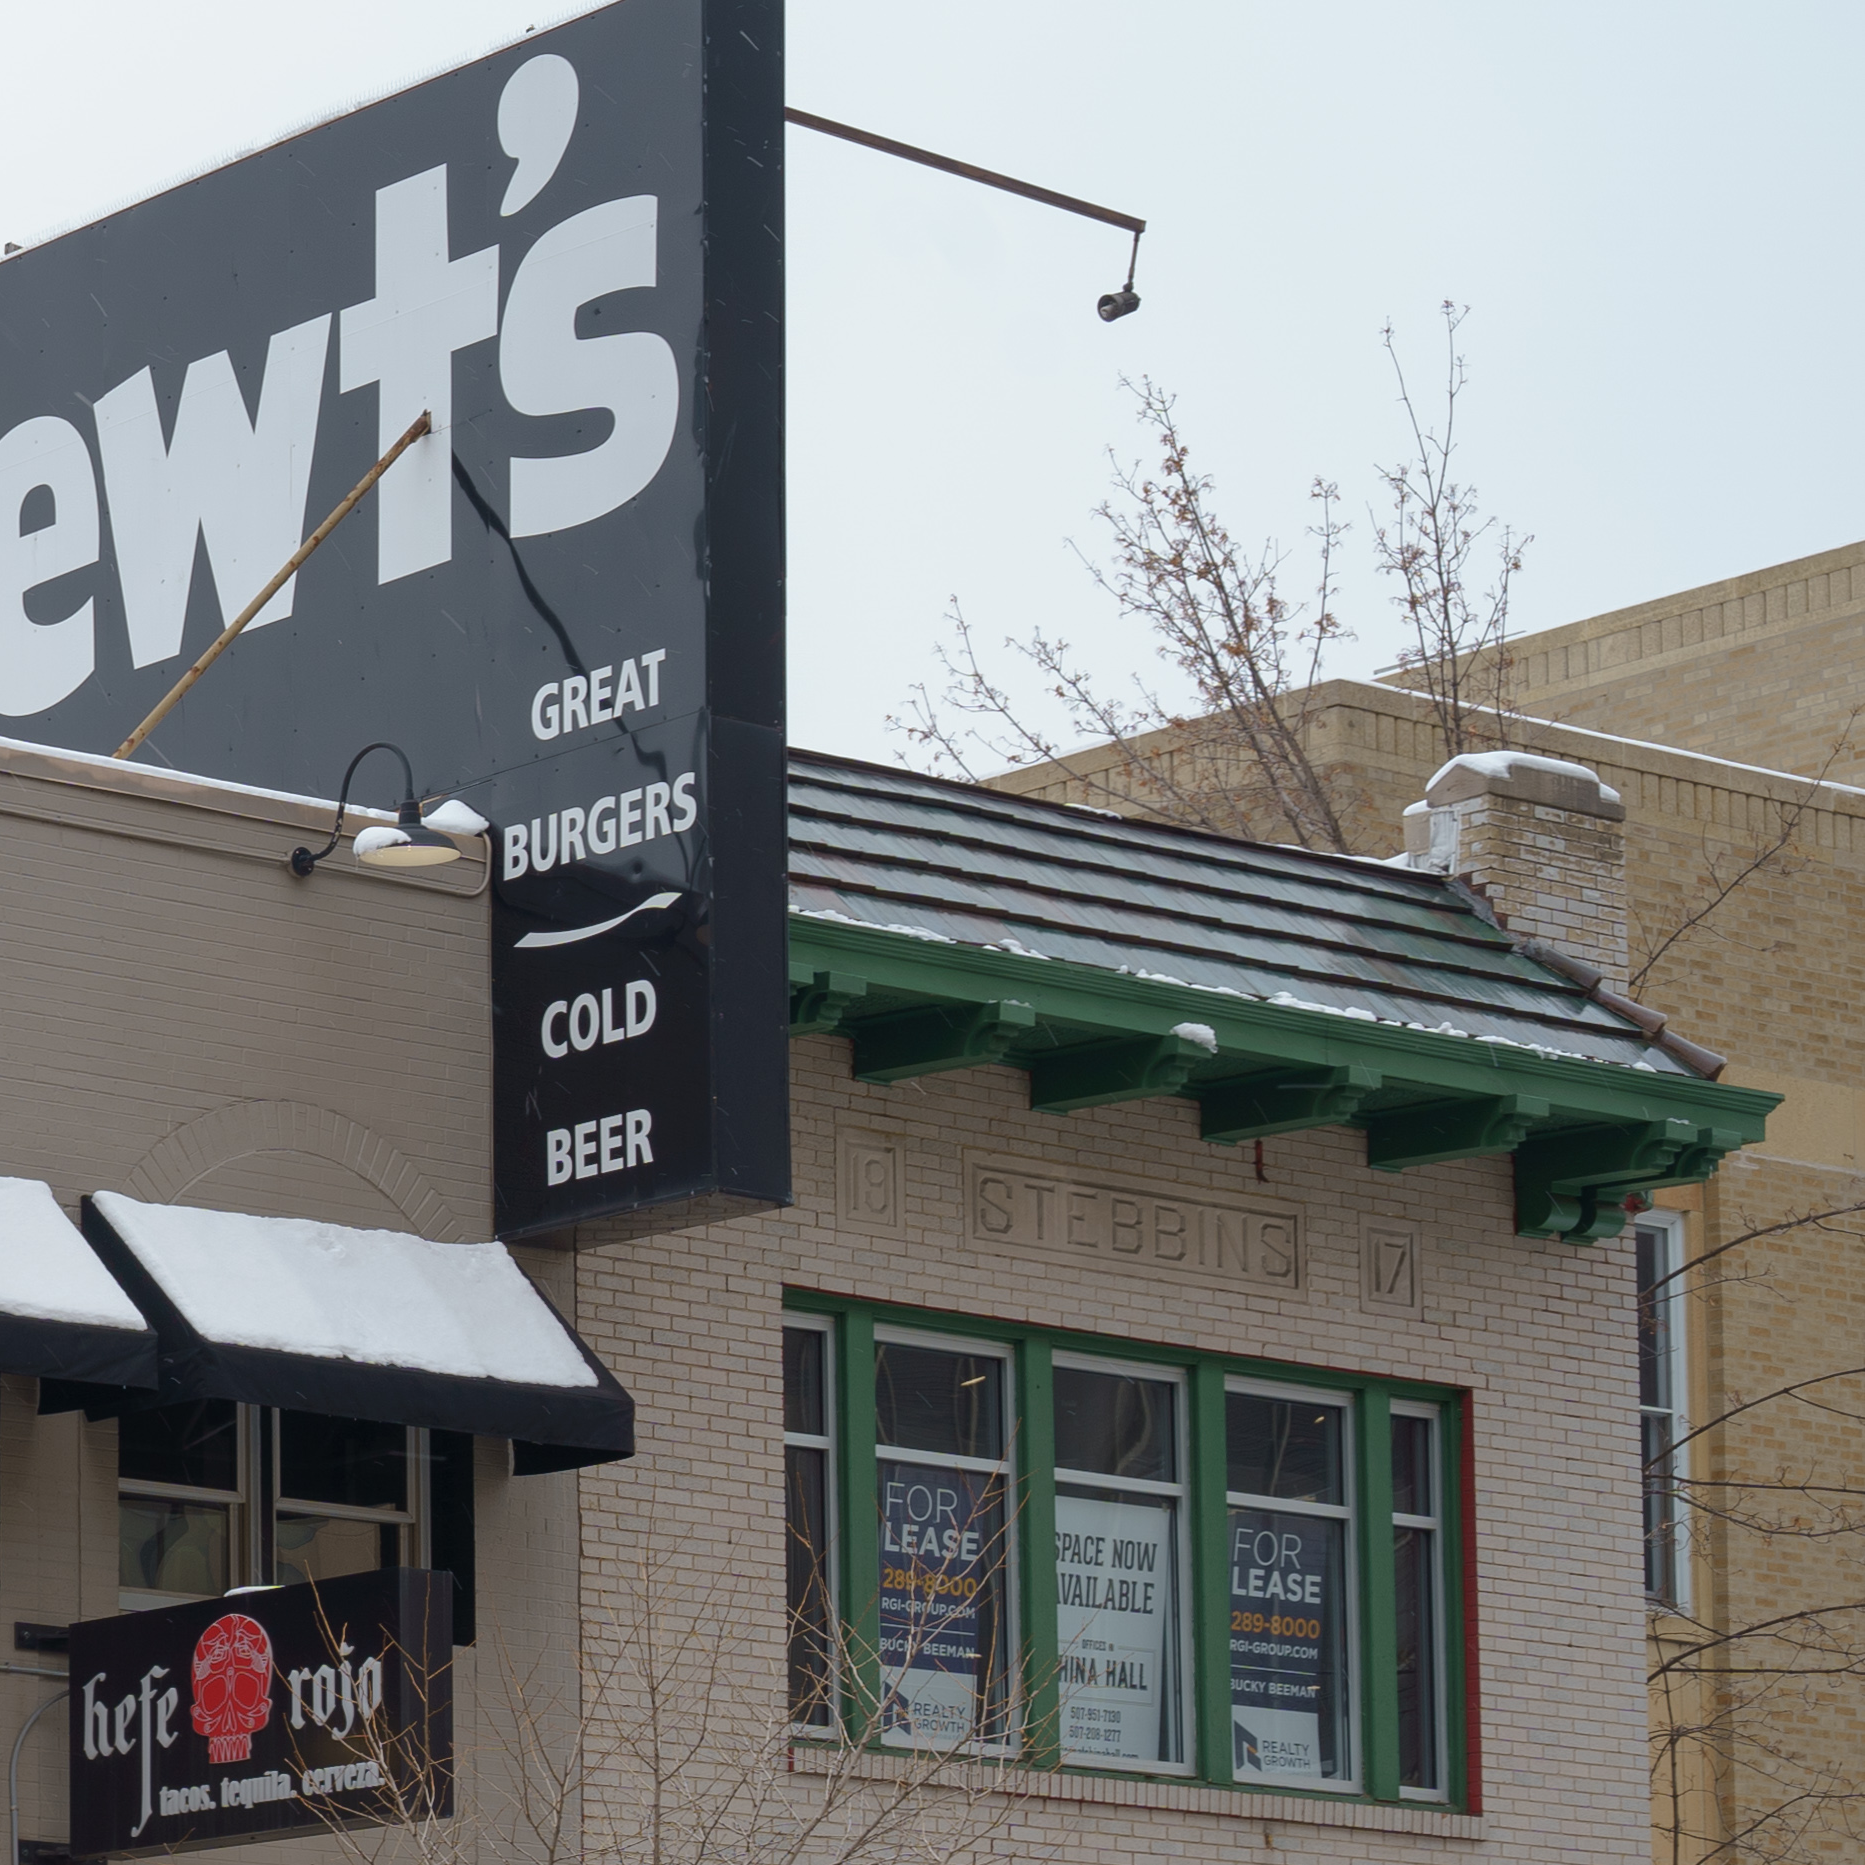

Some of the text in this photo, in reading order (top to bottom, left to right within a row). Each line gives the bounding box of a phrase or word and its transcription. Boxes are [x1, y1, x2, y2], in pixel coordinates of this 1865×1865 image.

[530, 647, 666, 741] GREAT
[503, 771, 697, 881] BURGERS
[541, 978, 657, 1059] COLD
[546, 1107, 653, 1187] BEER
[978, 1175, 1292, 1280] STEBBINS
[1373, 1237, 1409, 1295] 17
[886, 1481, 958, 1523] FOR
[884, 1521, 979, 1561] LEASE
[1111, 1539, 1158, 1572] NOW
[1233, 1528, 1302, 1569] FOR
[882, 1567, 977, 1598] 289-8000
[1231, 1566, 1322, 1604] LEASE
[881, 1596, 976, 1619] RGI-GROUP.COM
[1231, 1610, 1321, 1639] 289-8000
[879, 1637, 975, 1660] BUCKY BEEMAN
[1229, 1638, 1318, 1660] RGI-GROUP.COM
[1058, 1653, 1148, 1691] HINA HALL
[1230, 1678, 1316, 1699] BUCKY BEEMAN
[913, 1702, 967, 1720] REALTY
[914, 1719, 965, 1733] GROWTH
[83, 1641, 383, 1838] hefe rojo
[1262, 1740, 1310, 1756] REALTY
[1263, 1755, 1310, 1770] GROWTH
[159, 1760, 386, 1816] tacos. tequila. cerveza.
